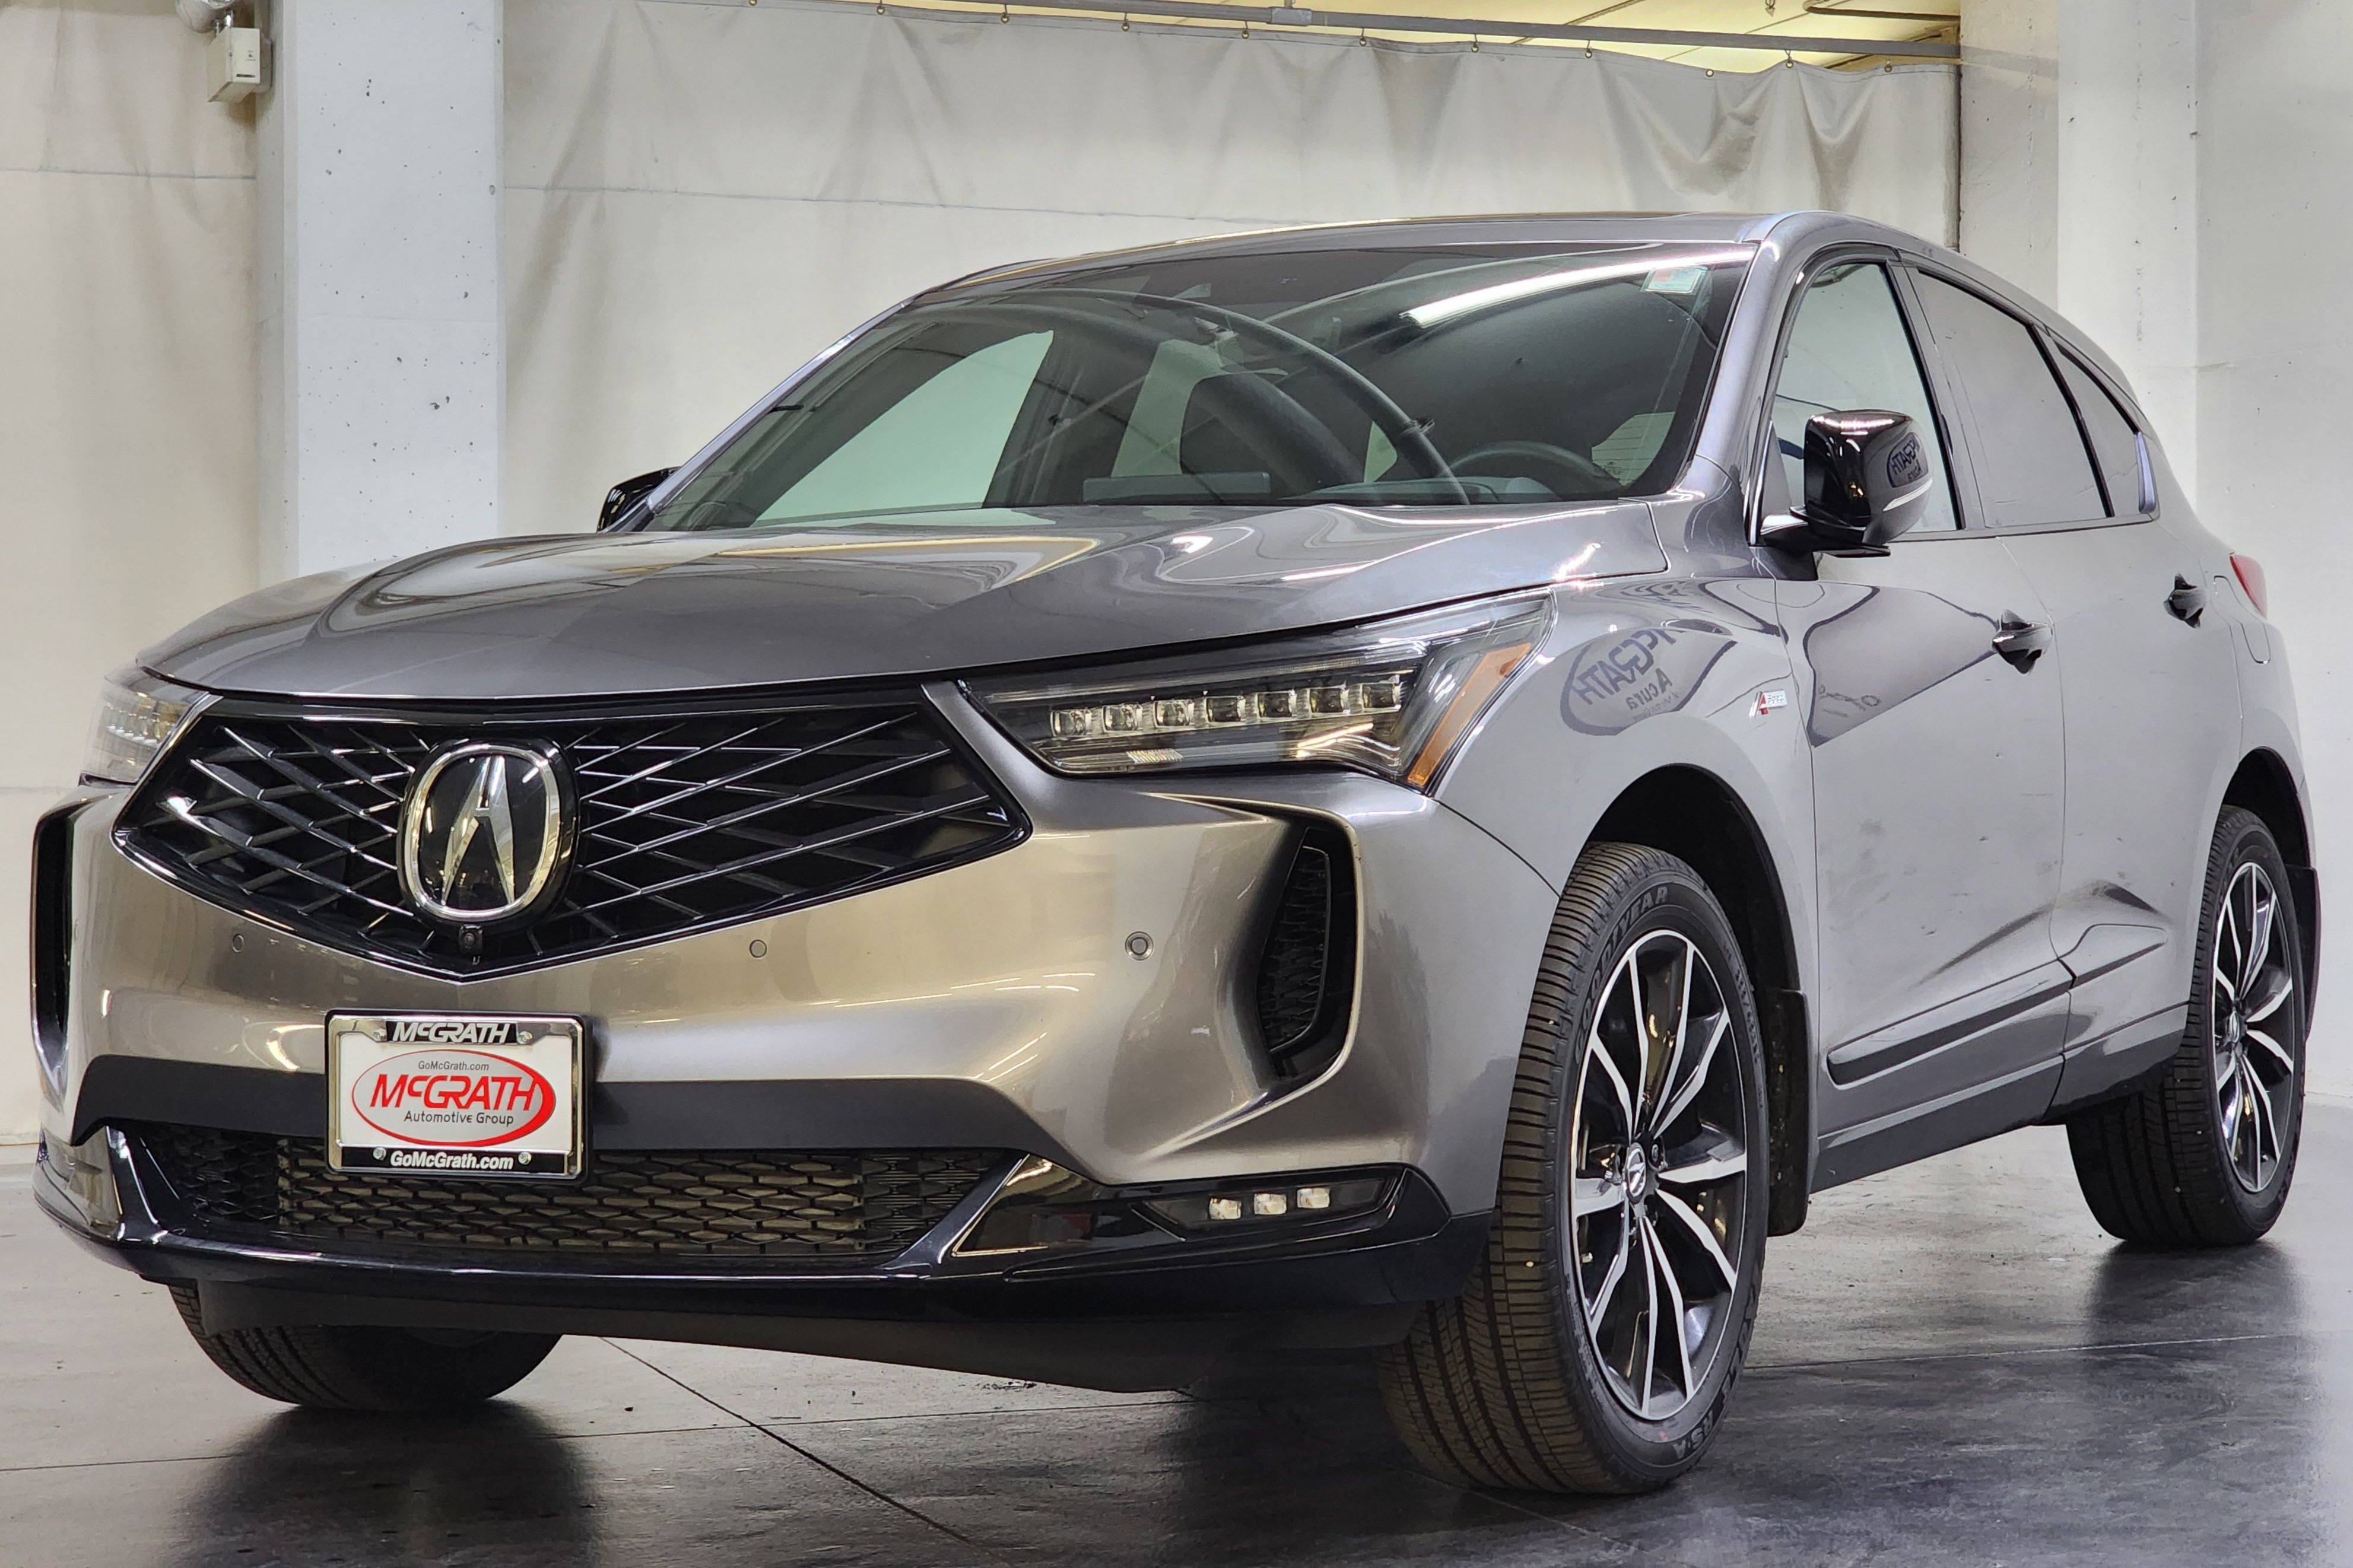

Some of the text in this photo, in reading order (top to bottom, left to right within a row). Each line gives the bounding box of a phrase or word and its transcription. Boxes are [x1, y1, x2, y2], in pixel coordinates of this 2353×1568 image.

[418, 1060, 489, 1071] GoMcGrath.com
[404, 1111, 514, 1127] Automotive Group
[390, 1150, 513, 1170] GoMcGrath.com
